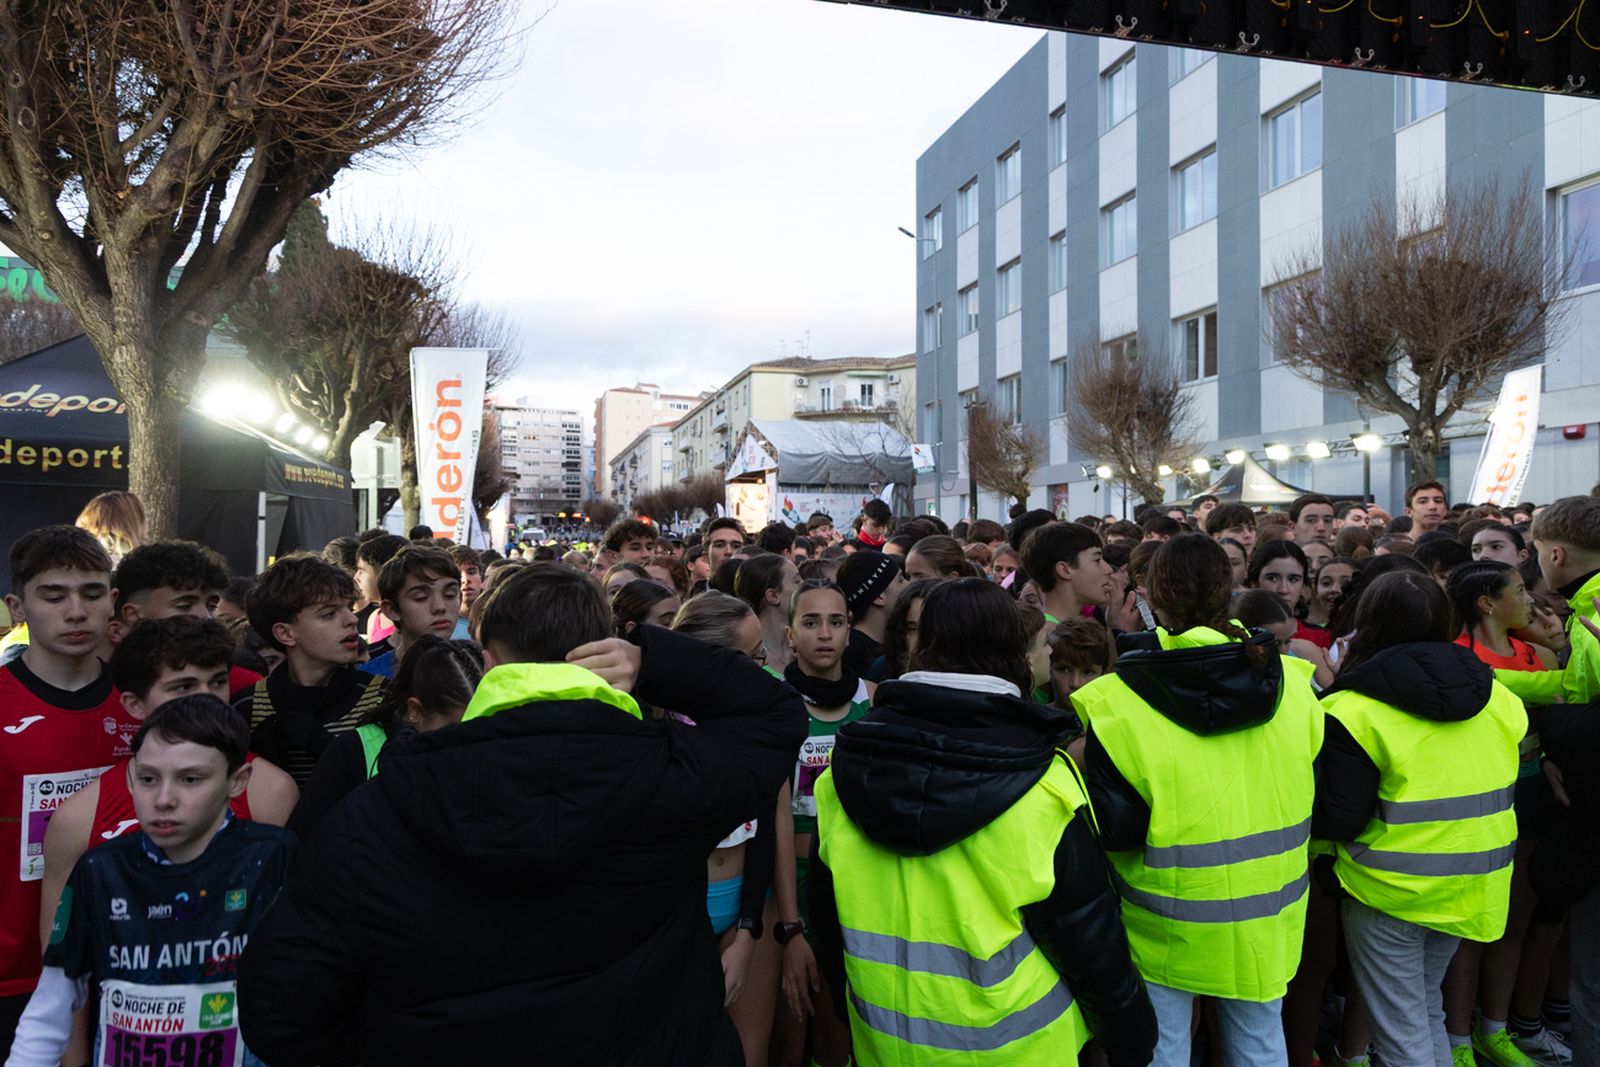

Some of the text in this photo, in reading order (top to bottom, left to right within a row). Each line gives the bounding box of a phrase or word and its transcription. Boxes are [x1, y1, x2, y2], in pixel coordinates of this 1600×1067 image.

[109, 931, 248, 970] SAN ANTÓN
[124, 999, 165, 1015] NOCHE
[167, 1001, 186, 1015] DE
[112, 1012, 133, 1030] SAN
[135, 1014, 185, 1033] ANTÓN
[112, 1032, 224, 1067] 15598
